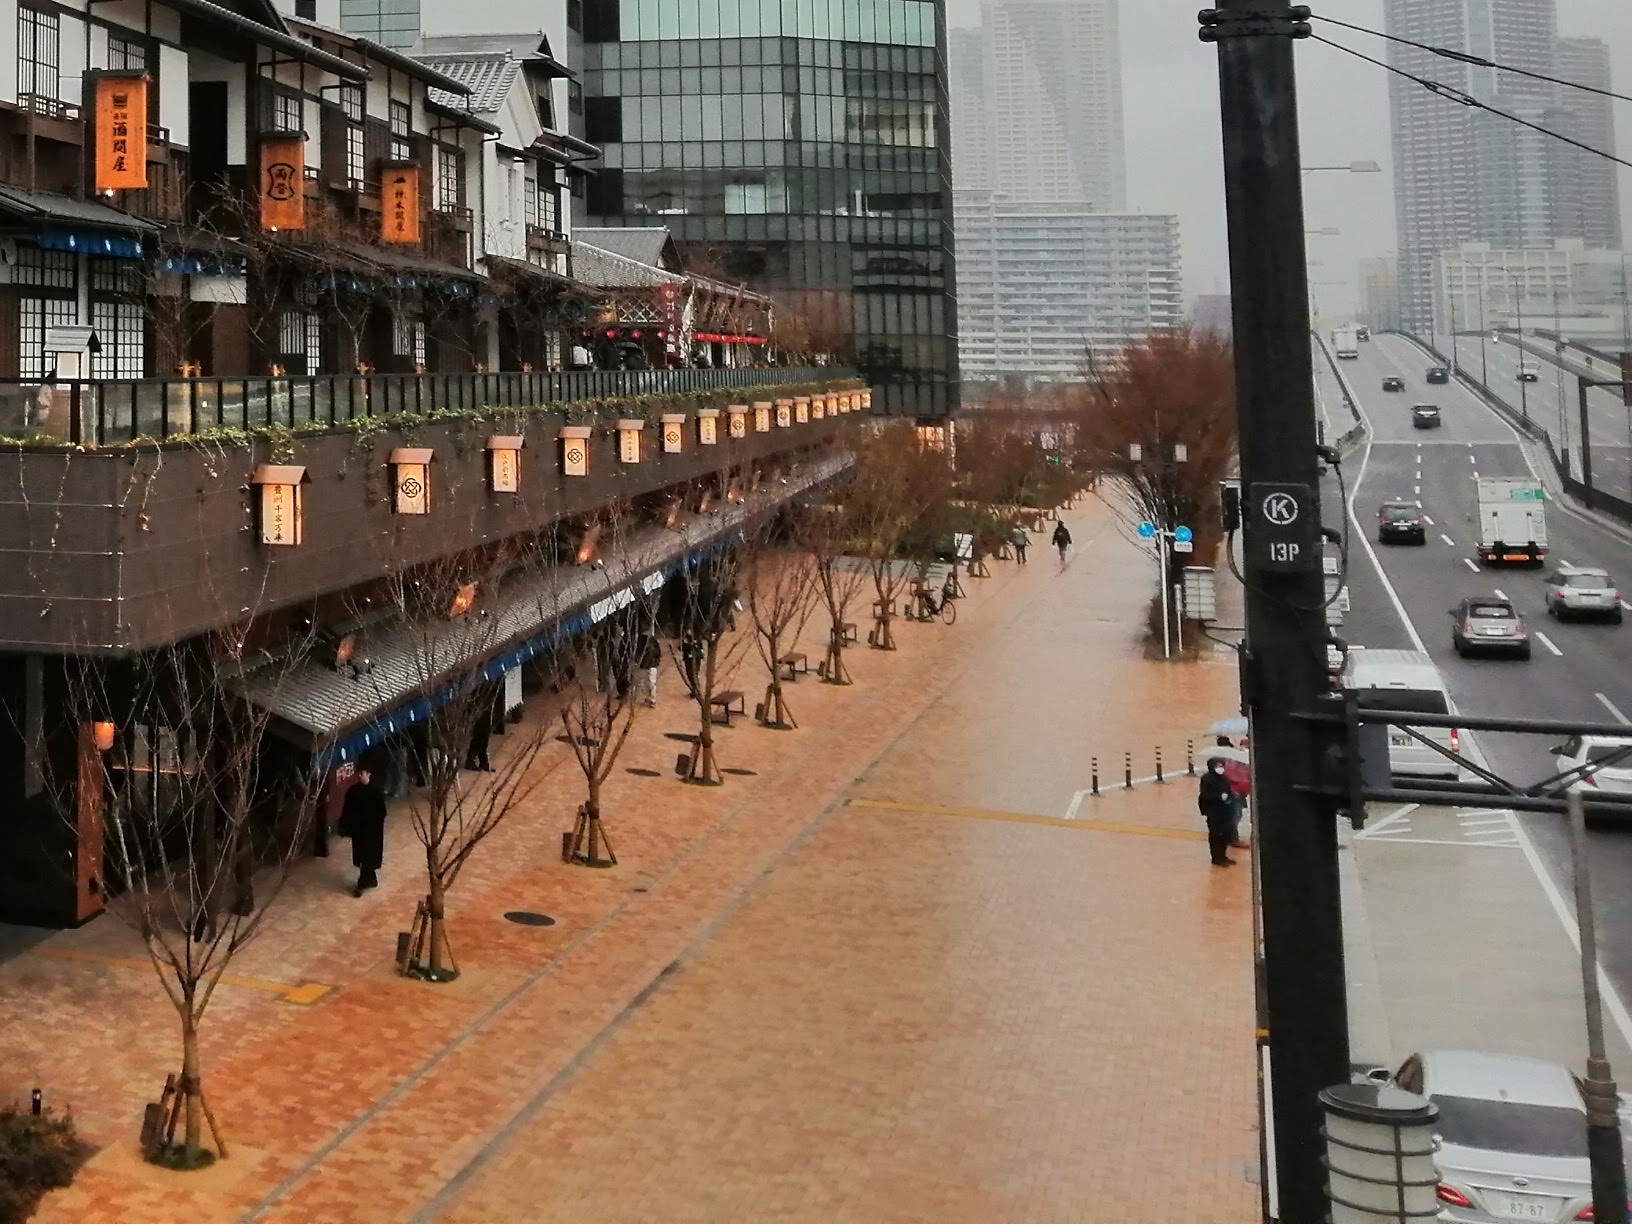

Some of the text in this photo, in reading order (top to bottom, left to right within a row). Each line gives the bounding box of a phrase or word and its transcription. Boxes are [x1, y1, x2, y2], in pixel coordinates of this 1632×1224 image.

[273, 484, 284, 543] 豊洲千客万来
[1270, 542, 1300, 562] 13P
[1510, 1203, 1545, 1216] 87-87
